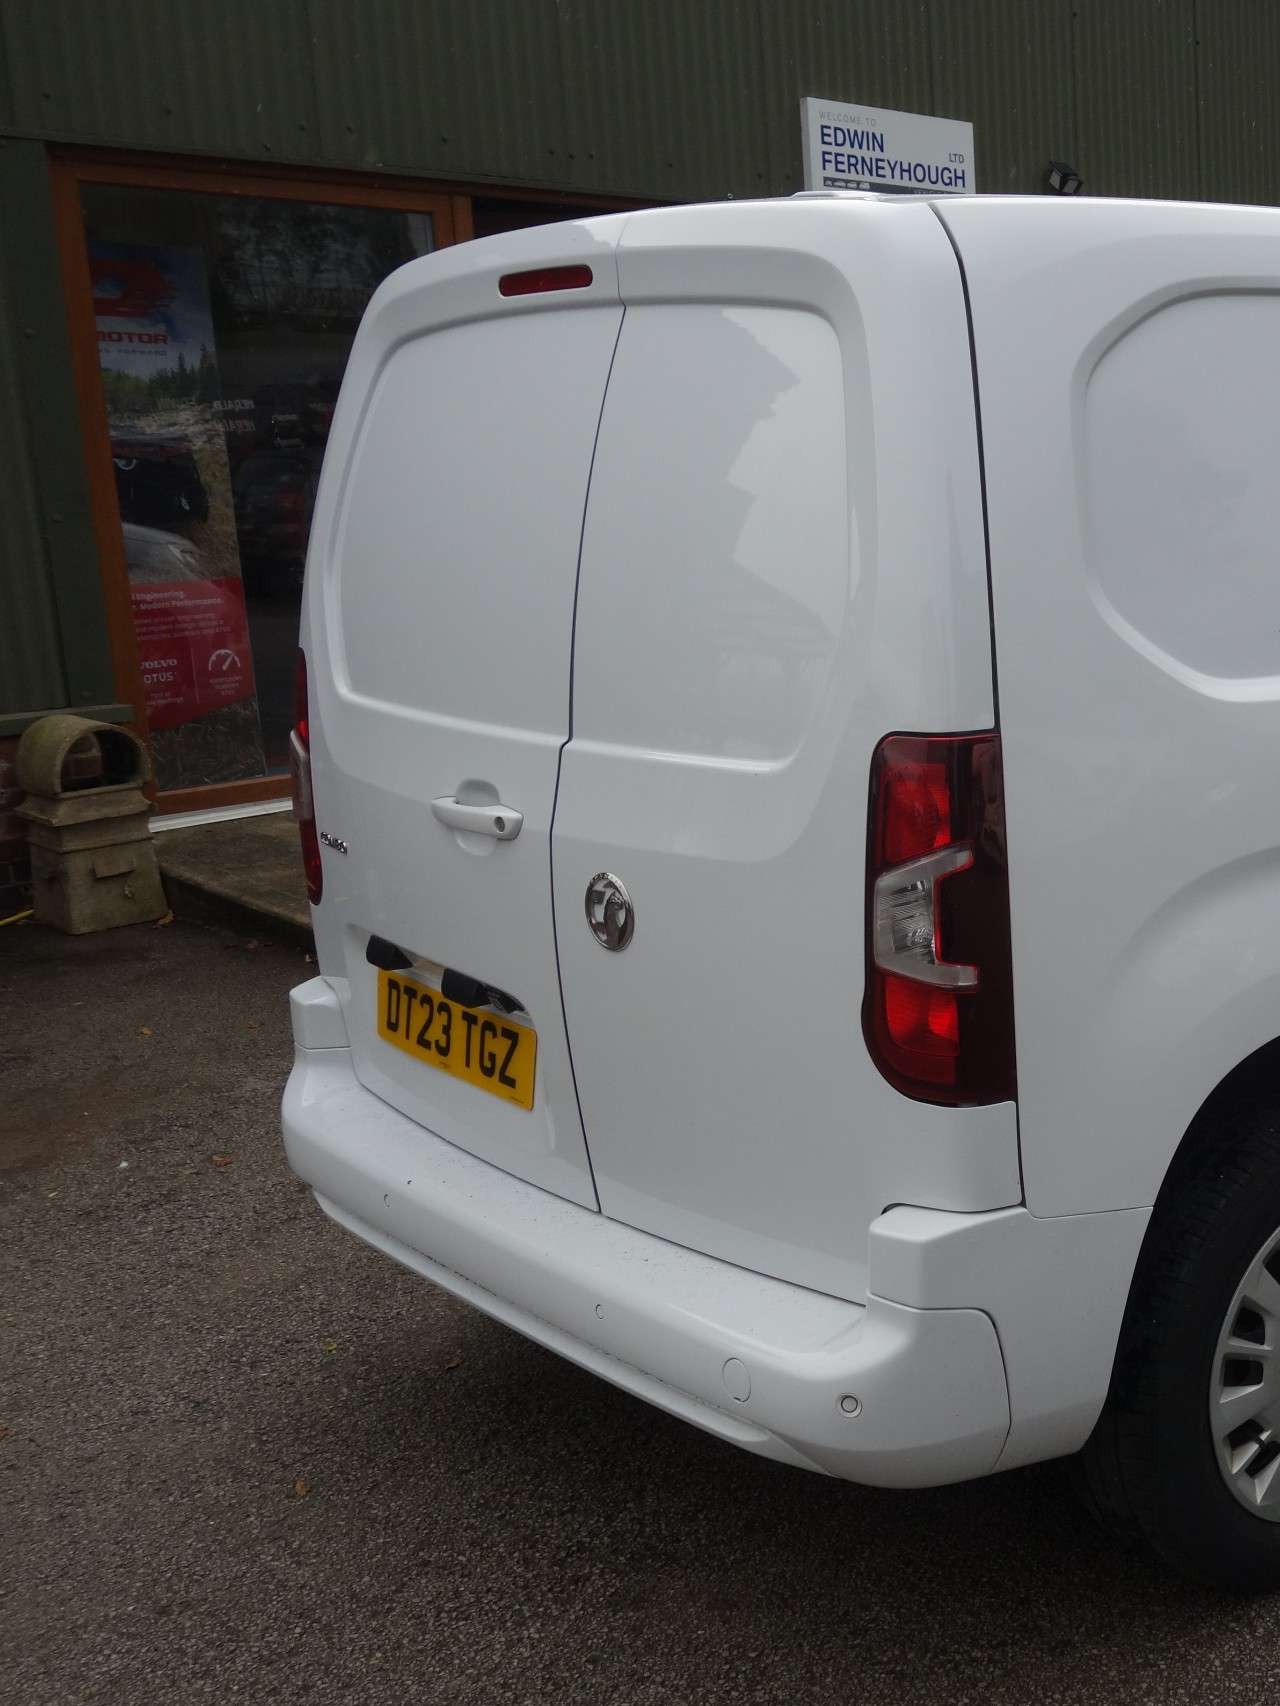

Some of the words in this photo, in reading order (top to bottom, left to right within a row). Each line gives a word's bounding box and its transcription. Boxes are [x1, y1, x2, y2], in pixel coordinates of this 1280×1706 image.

[819, 111, 862, 125] WELCOME
[865, 117, 877, 127] TO
[820, 124, 884, 152] EDWIN
[948, 152, 965, 163] LTD
[822, 151, 966, 188] FERNEYHOUGH
[144, 672, 174, 684] OTUS
[386, 977, 453, 1058] DT23
[461, 1012, 521, 1089] TGZ
